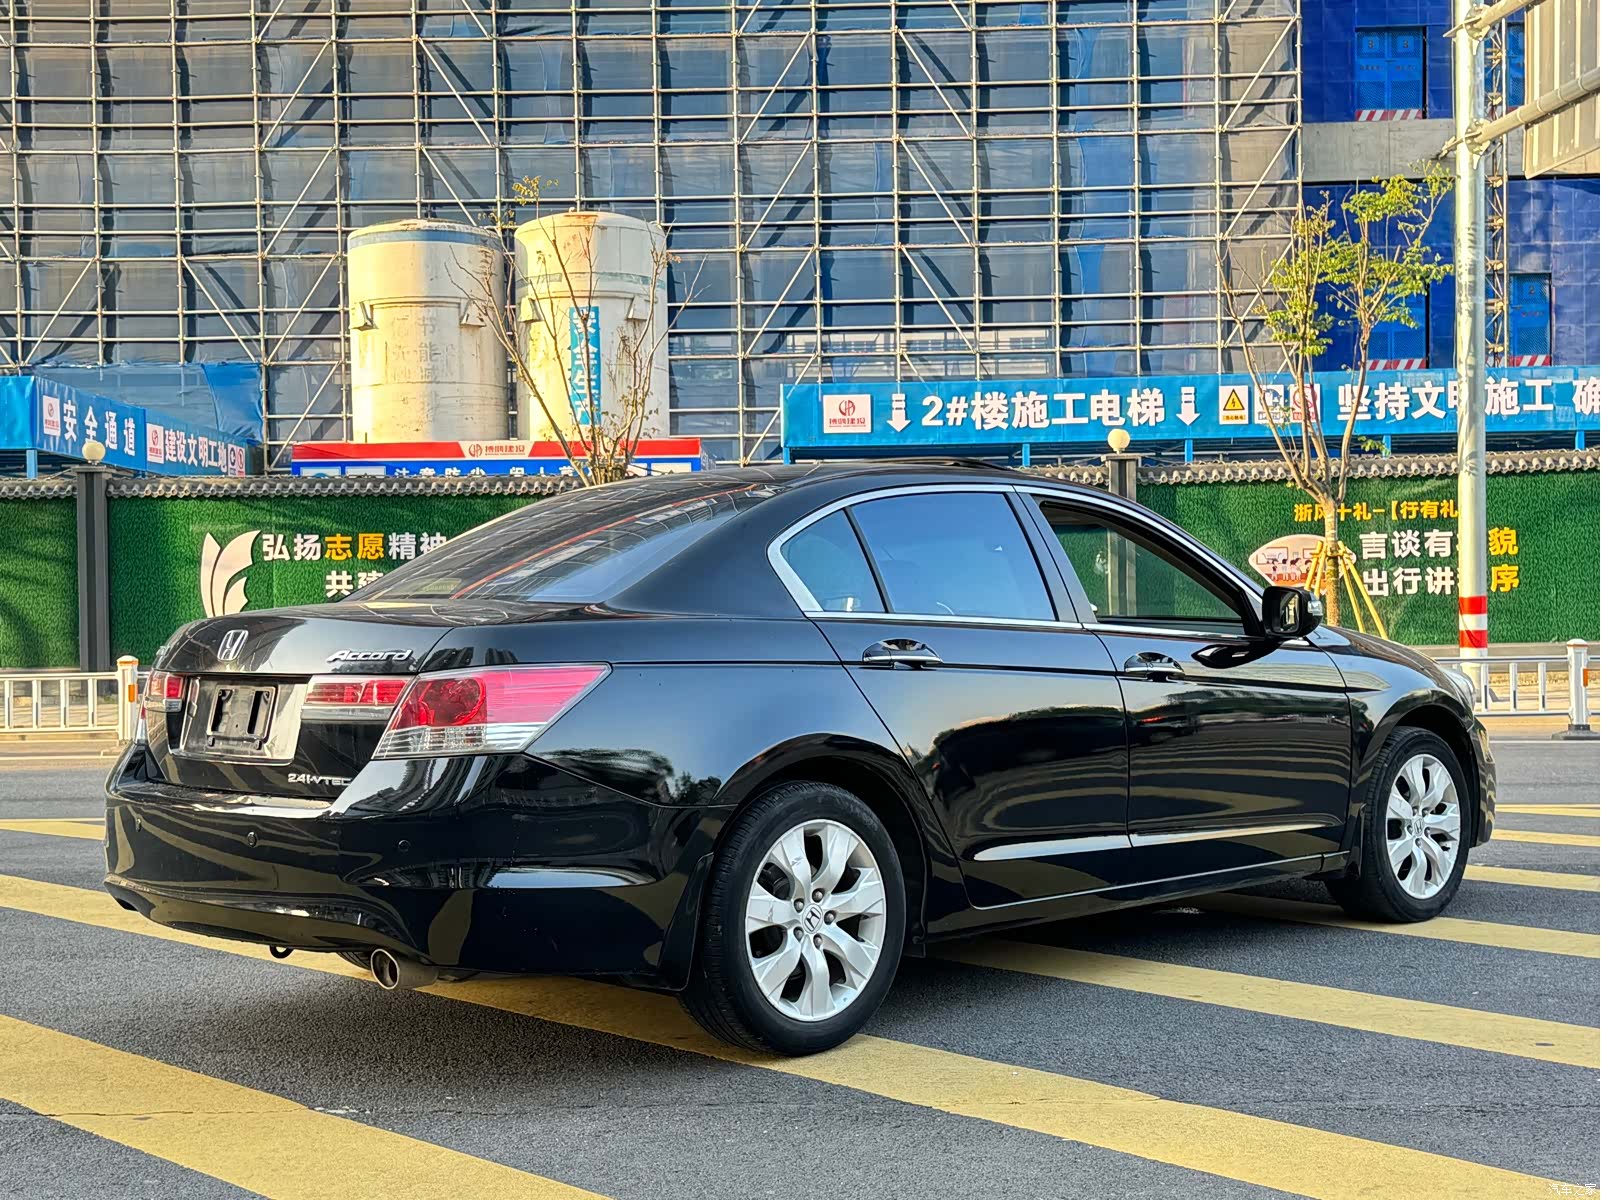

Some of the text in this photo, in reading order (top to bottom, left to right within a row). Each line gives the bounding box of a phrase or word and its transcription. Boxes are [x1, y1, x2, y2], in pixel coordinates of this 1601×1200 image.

[921, 388, 1166, 430] 2#楼施工电梯
[63, 399, 136, 457] 安全通道
[164, 429, 228, 473] 建设文明工地
[1358, 527, 1519, 560] 言谈有貌
[1363, 564, 1520, 597] 出行讲序
[325, 649, 414, 663] Accord
